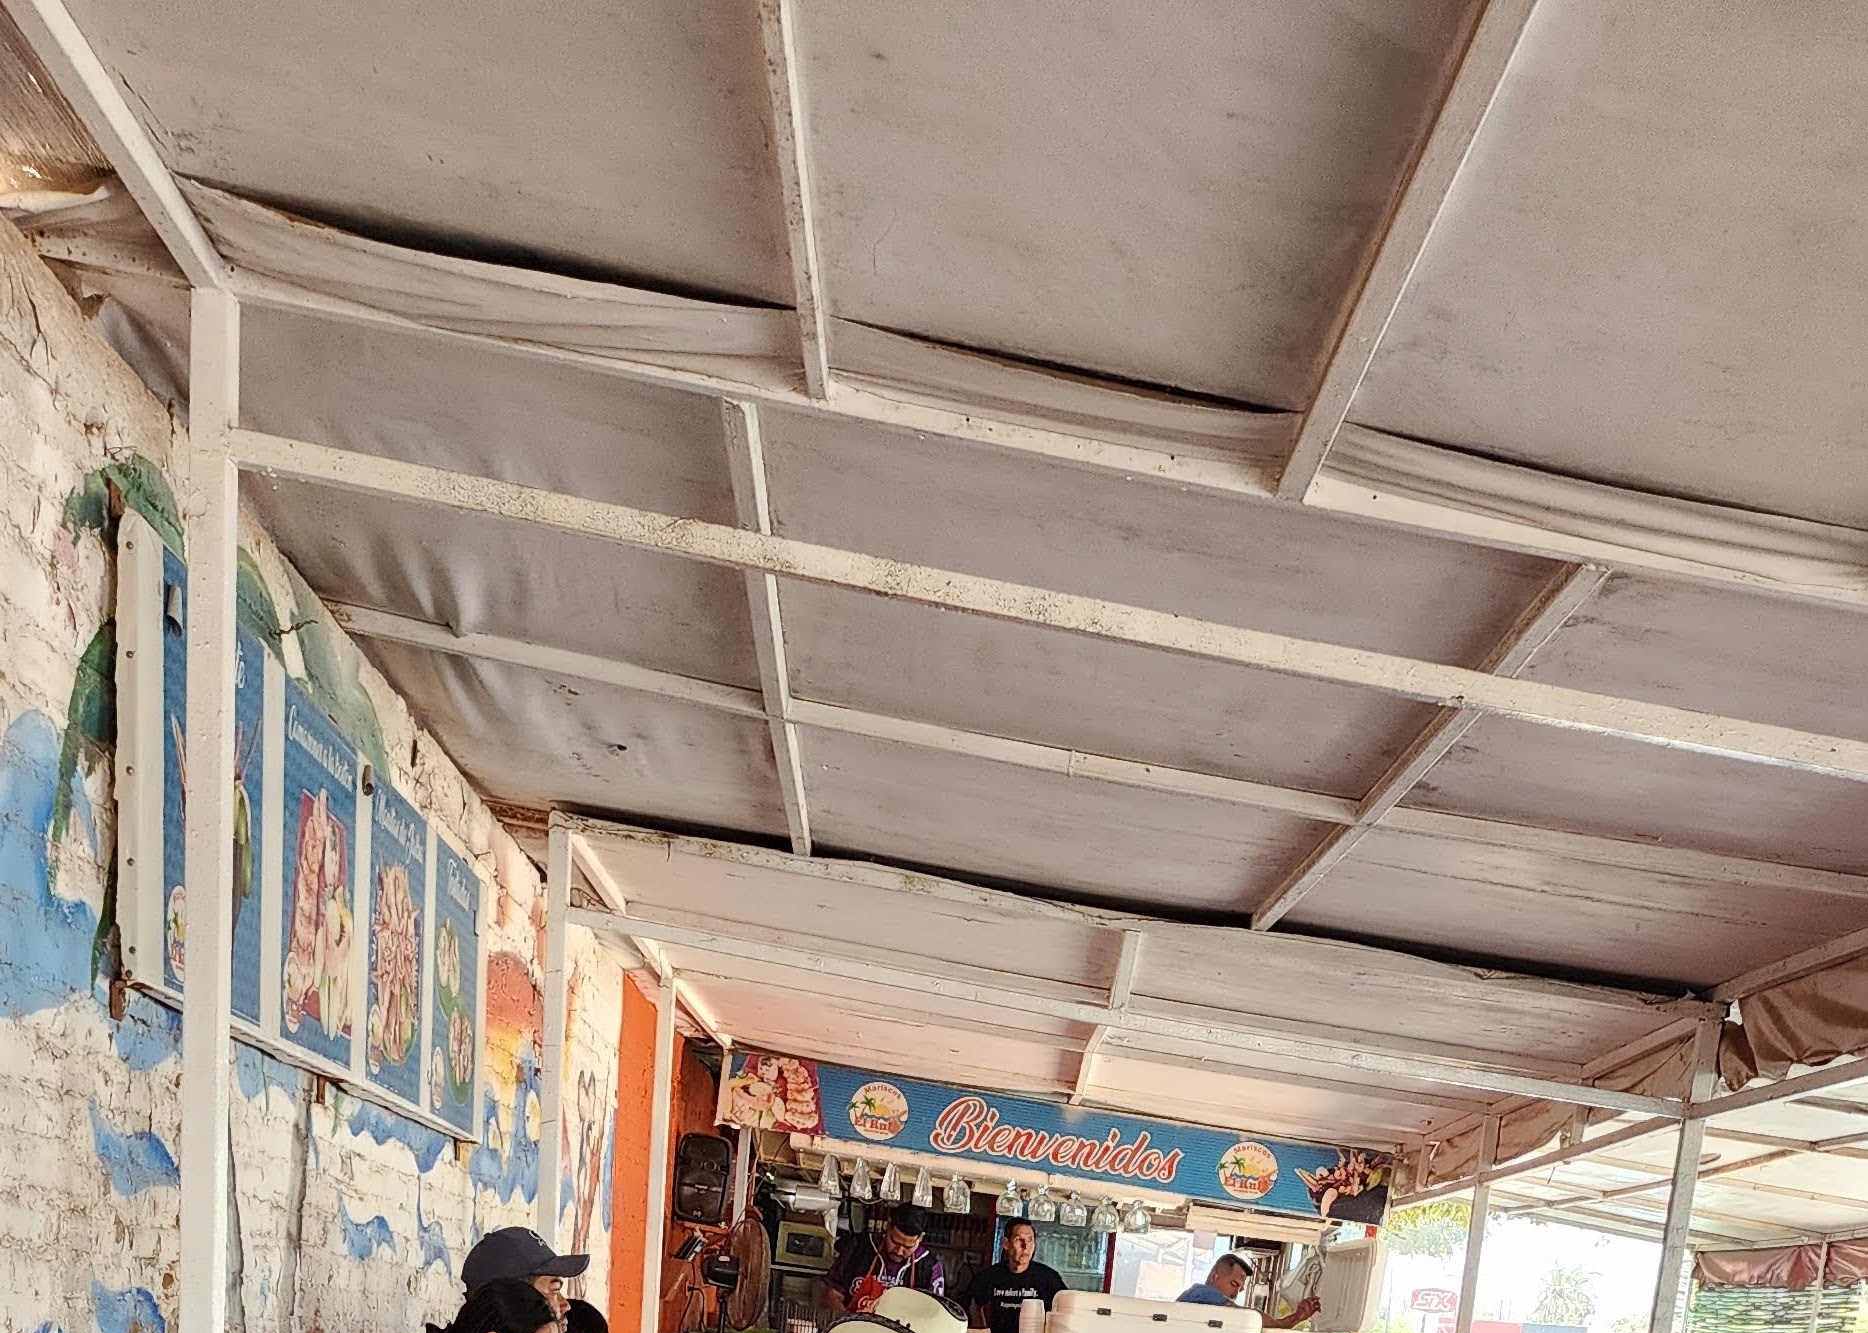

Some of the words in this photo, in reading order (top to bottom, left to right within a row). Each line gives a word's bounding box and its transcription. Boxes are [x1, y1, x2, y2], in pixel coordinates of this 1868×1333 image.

[864, 1084, 902, 1100] Mariscos
[930, 1096, 1185, 1183] Bienvenidos
[1233, 1144, 1271, 1160] Mariscos
